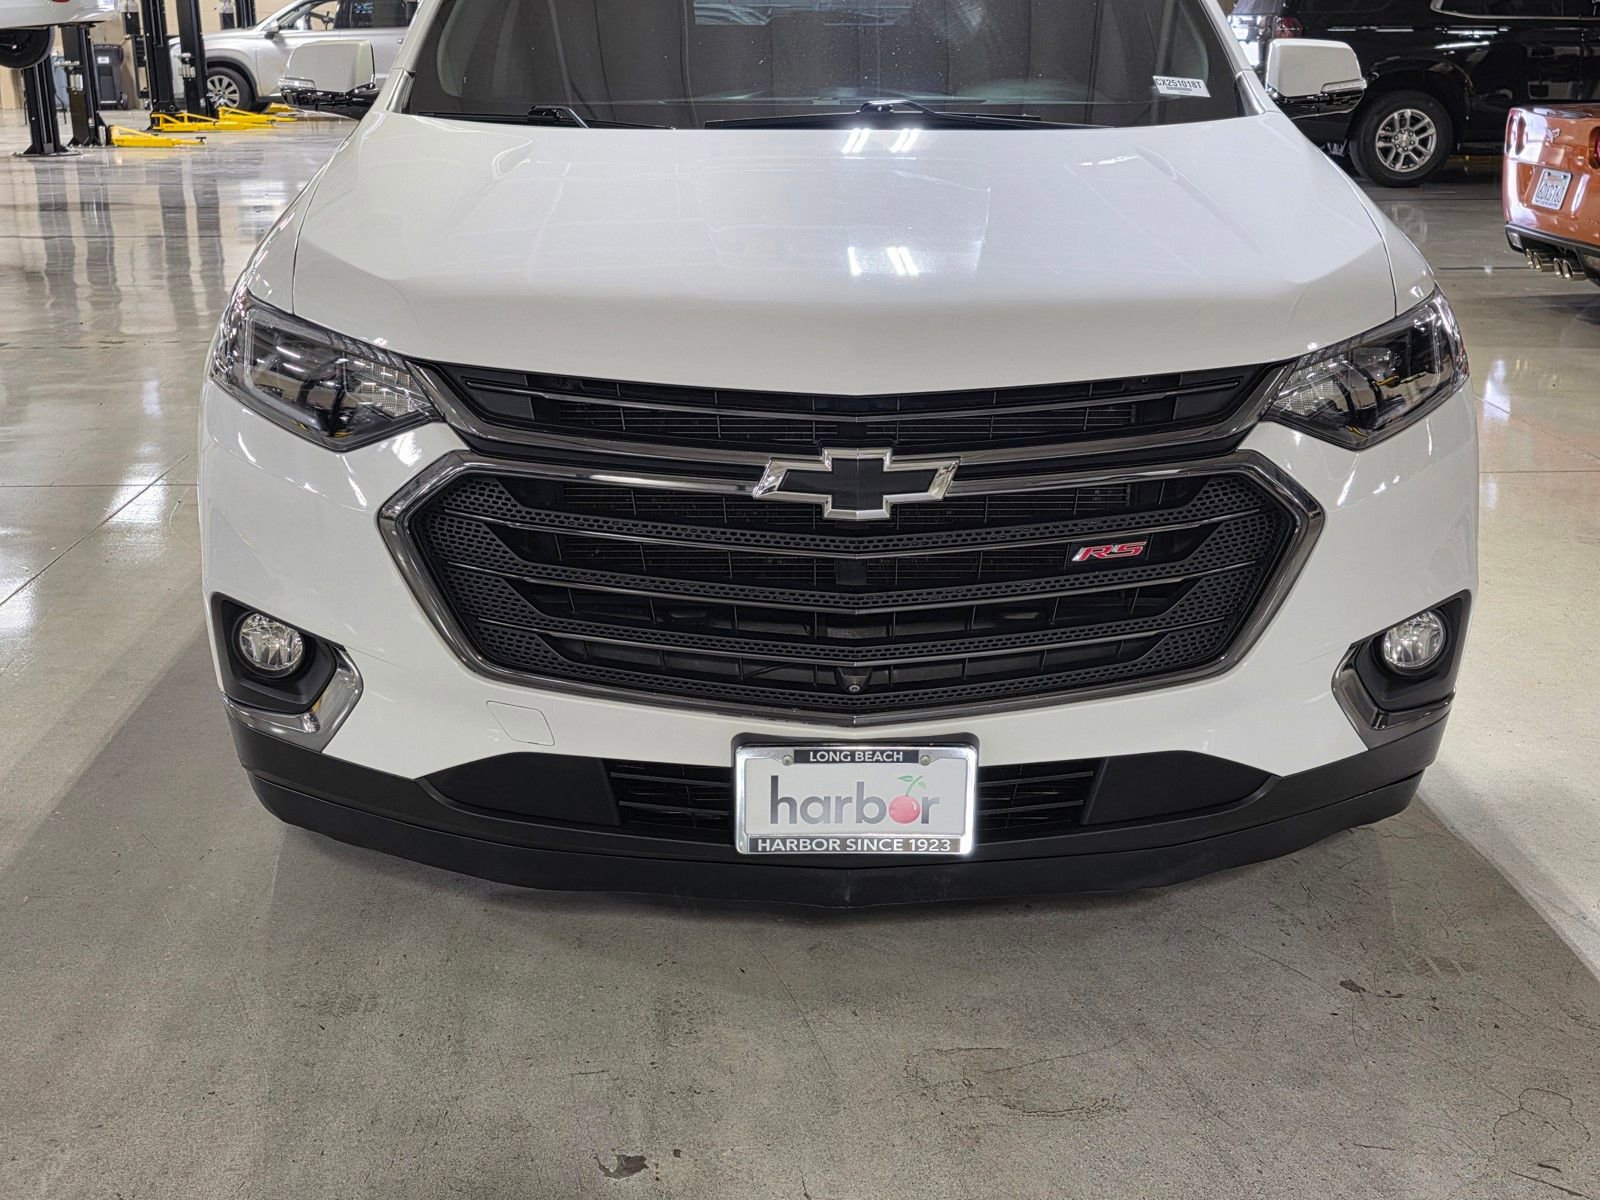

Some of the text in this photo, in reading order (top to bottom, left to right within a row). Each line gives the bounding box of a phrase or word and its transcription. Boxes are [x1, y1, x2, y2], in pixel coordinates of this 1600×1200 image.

[1072, 541, 1147, 561] RS
[809, 751, 903, 762] LONG BEACH
[770, 775, 940, 825] harbor
[757, 838, 951, 852] HARBOR SINCE 1923
